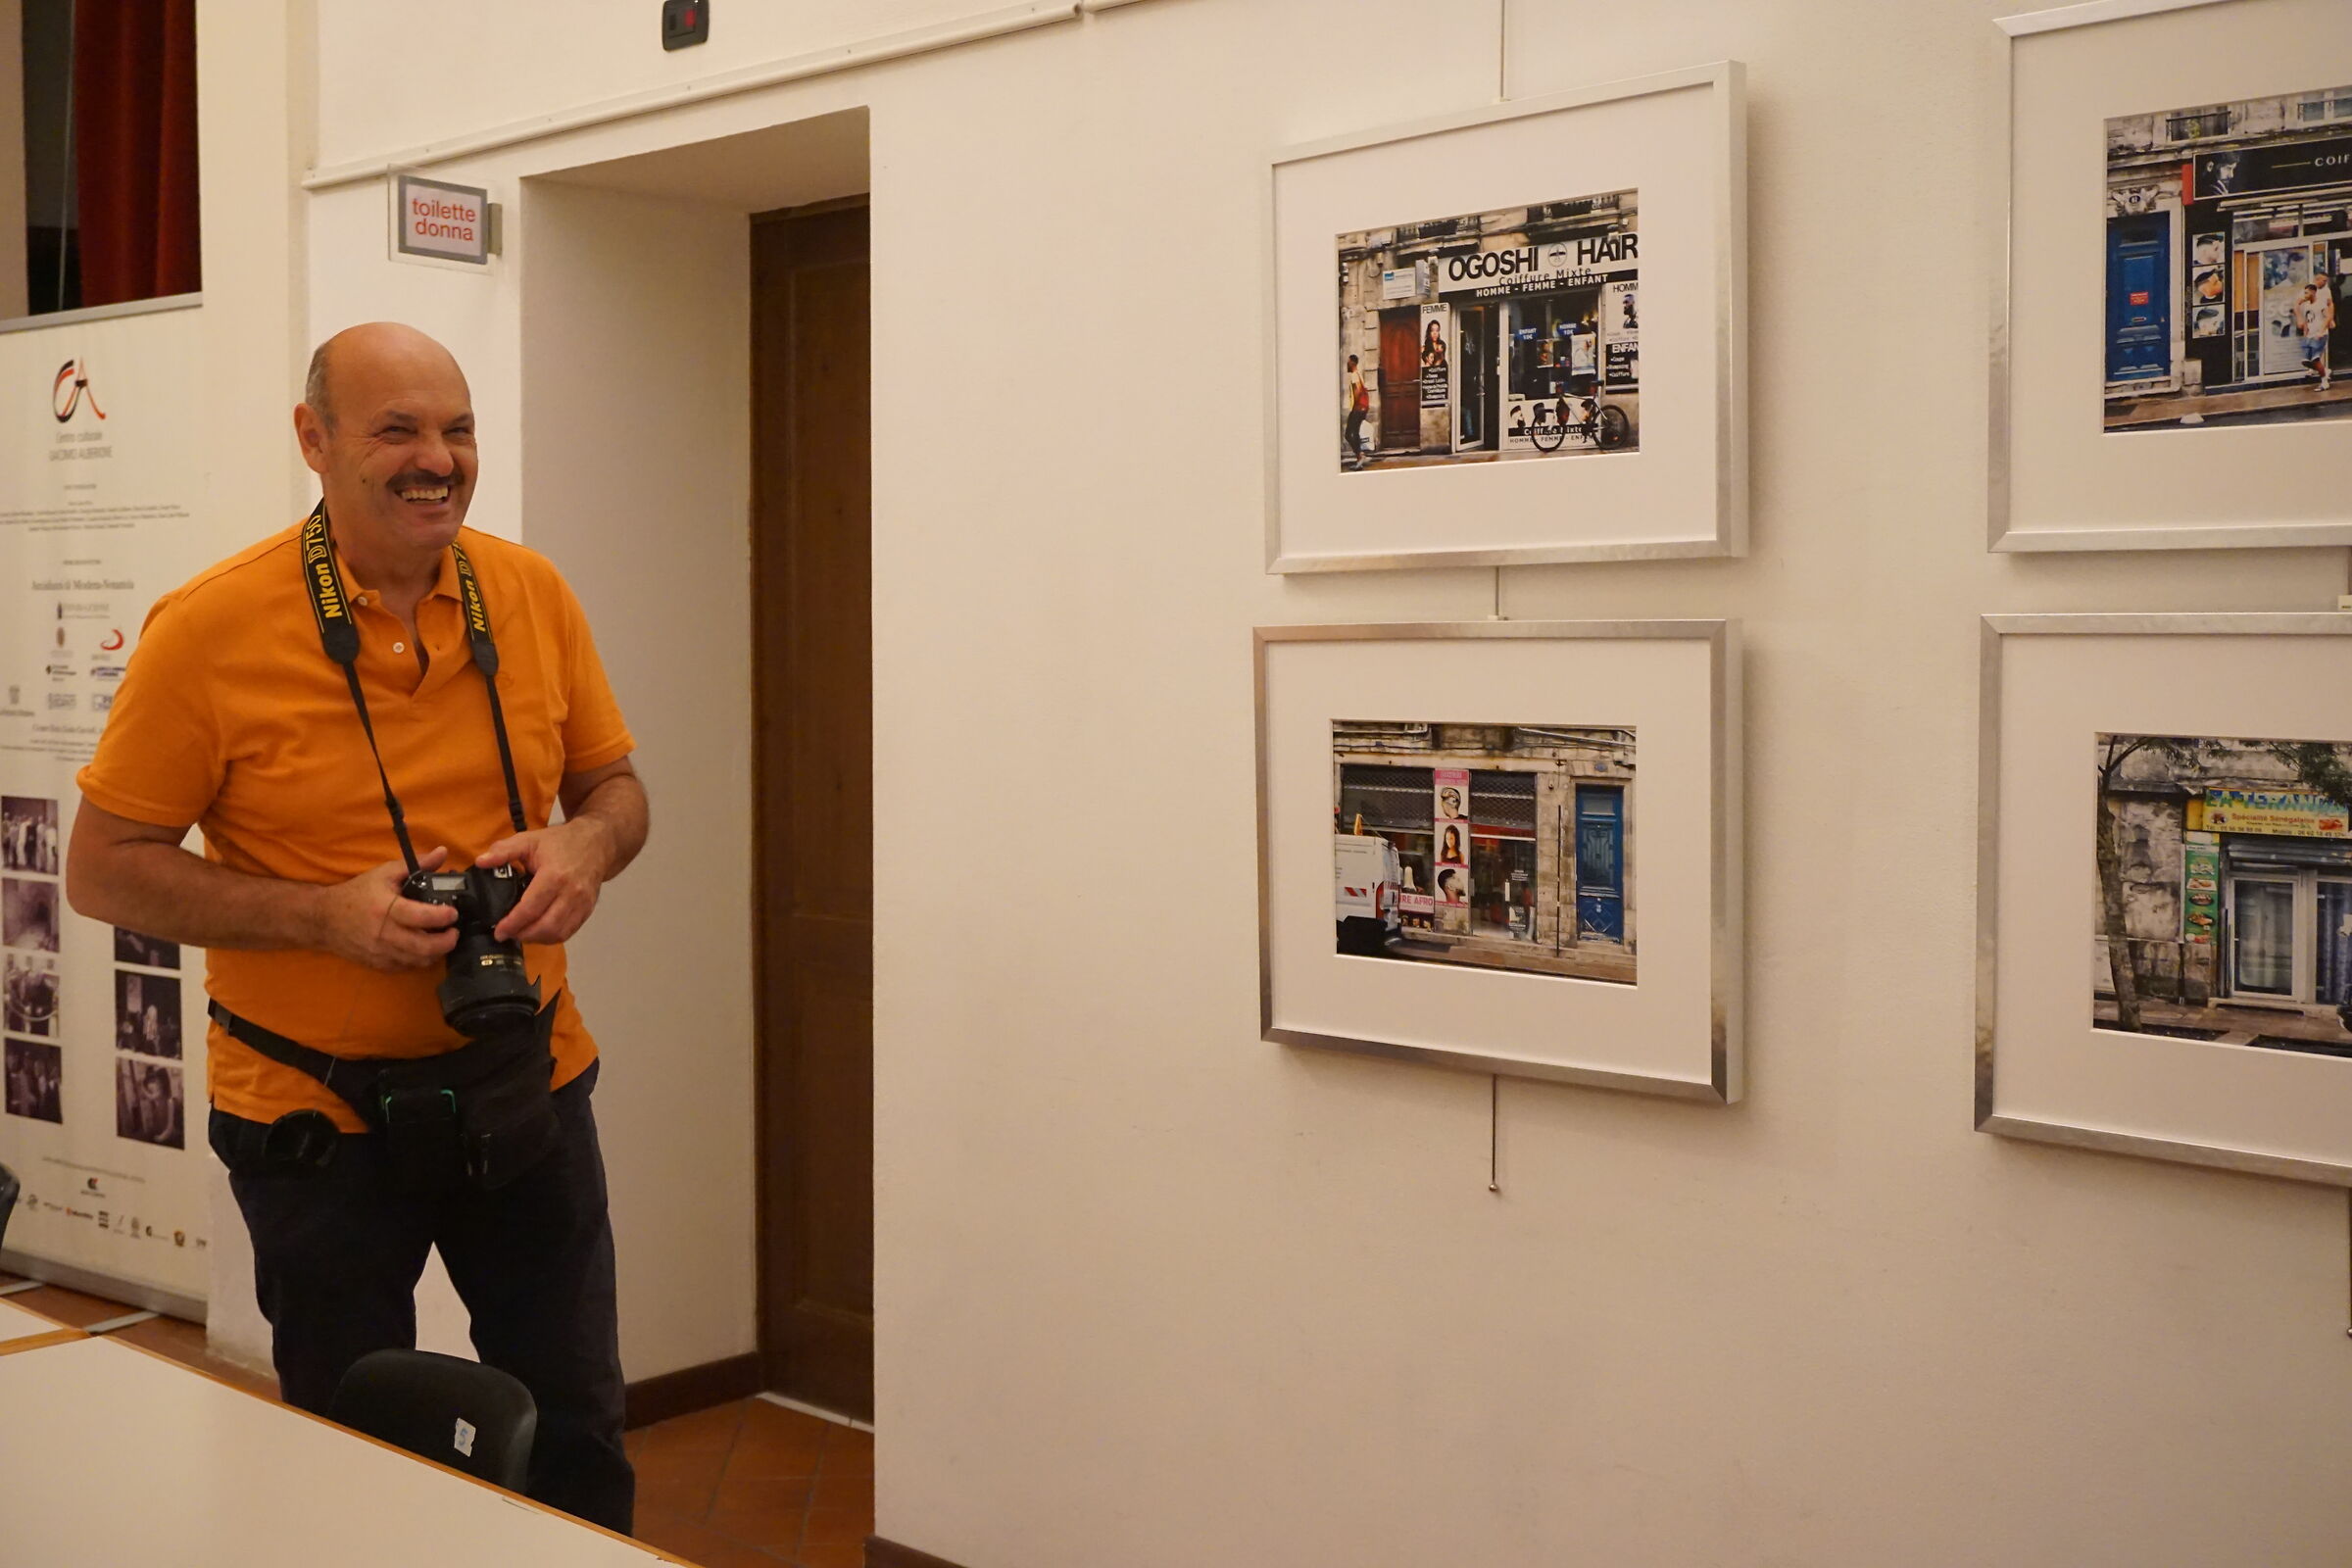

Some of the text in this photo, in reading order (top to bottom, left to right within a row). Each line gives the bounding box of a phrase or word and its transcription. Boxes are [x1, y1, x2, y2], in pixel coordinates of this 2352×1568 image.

[413, 198, 476, 222] toilette
[415, 219, 474, 241] donna
[1448, 233, 1639, 281] OGOSHI HAIR
[1476, 285, 1511, 297] HOMME
[1522, 281, 1556, 292] FEMME
[1568, 274, 1608, 286] ENFANT
[1498, 267, 1592, 285] Coiffure Mixte
[316, 563, 343, 618] Nikon
[465, 579, 486, 633] Nikon
